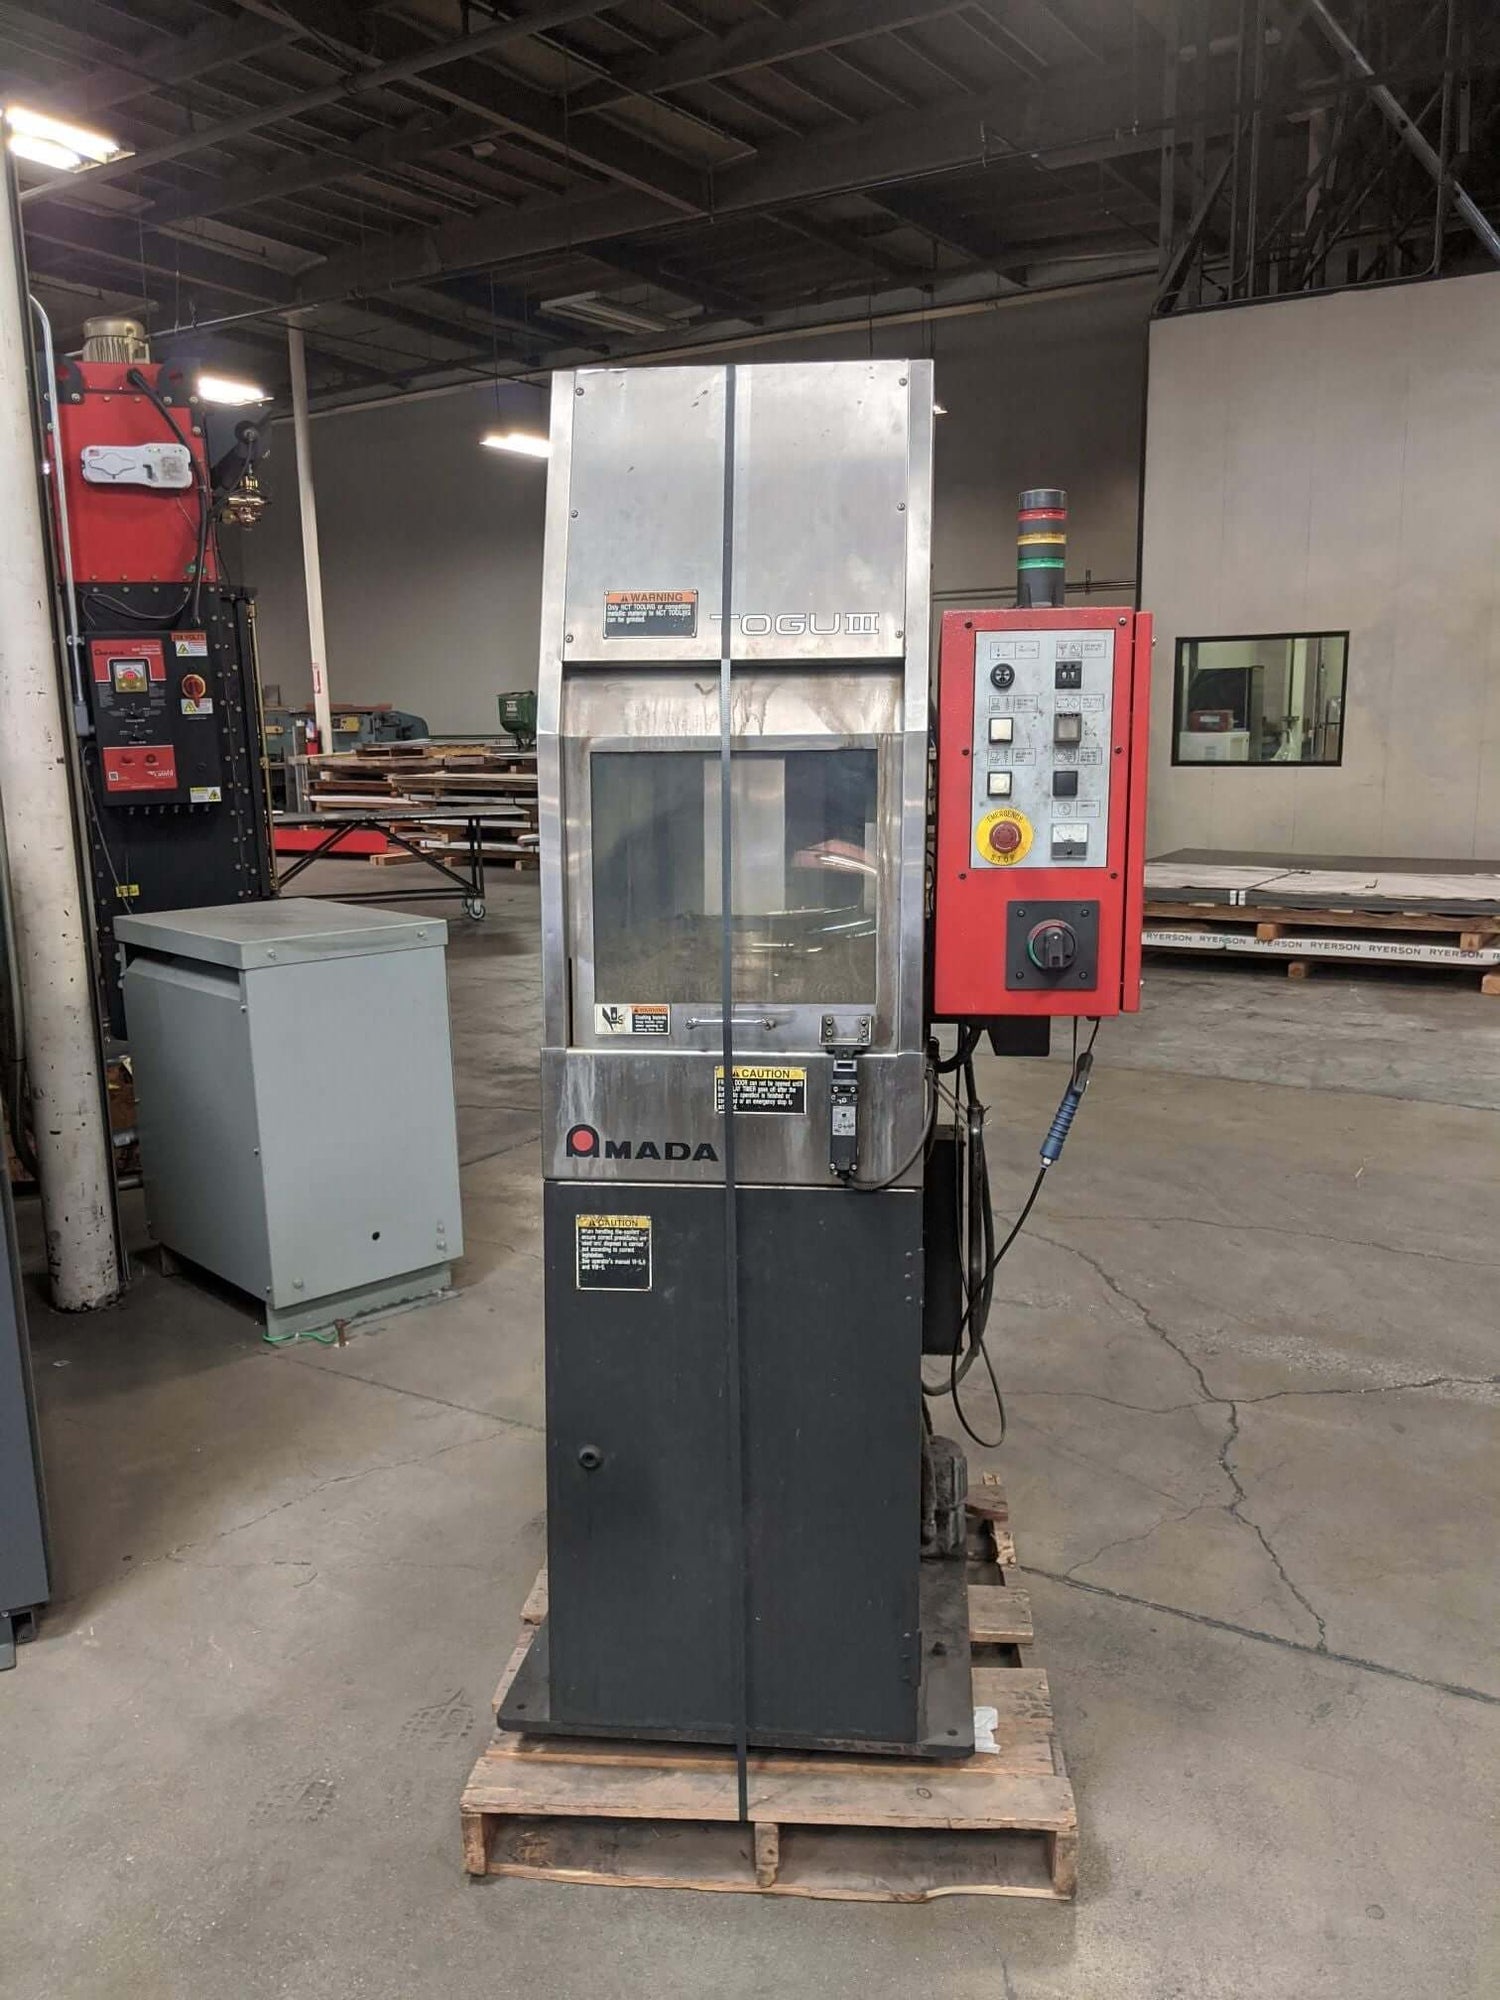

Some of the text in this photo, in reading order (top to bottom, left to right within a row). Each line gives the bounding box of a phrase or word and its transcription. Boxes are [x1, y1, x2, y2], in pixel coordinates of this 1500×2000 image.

[631, 593, 683, 602] WARNING
[607, 603, 620, 611] Only
[986, 810, 1023, 823] EMERGENCY
[991, 854, 1015, 863] STOP
[1146, 931, 1192, 942] RYERSON
[1200, 935, 1246, 945] RYERSON
[1310, 941, 1360, 951] RYERSON
[1369, 944, 1420, 955] RYERSON
[1430, 948, 1483, 959] RYERSON
[742, 1069, 790, 1078] CAUTION
[566, 1123, 719, 1162] AMADA
